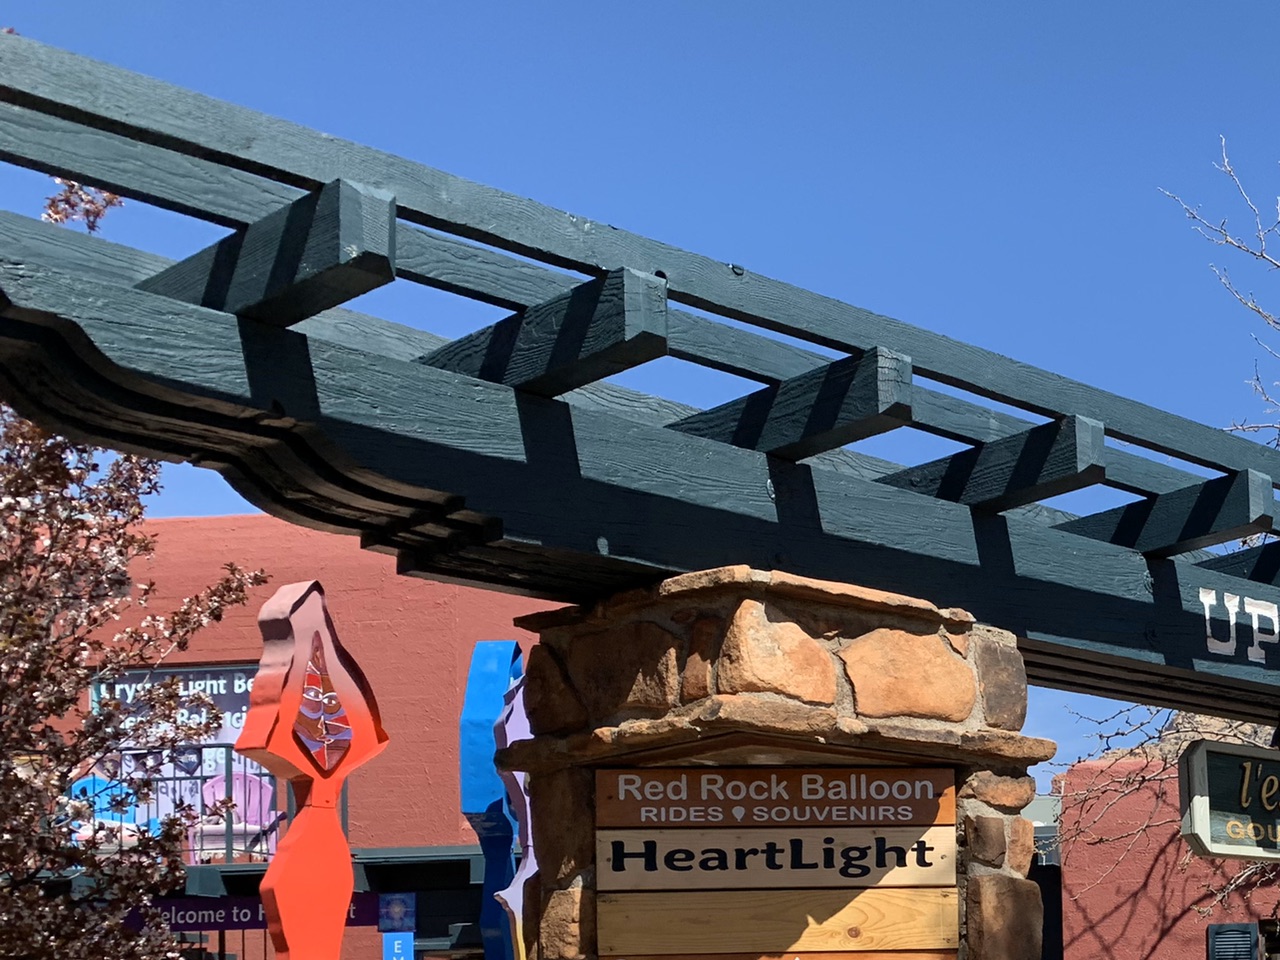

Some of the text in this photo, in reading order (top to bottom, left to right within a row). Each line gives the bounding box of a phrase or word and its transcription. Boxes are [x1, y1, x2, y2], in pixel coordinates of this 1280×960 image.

[177, 672, 227, 697] Light
[617, 772, 935, 801] Red Rock Balloon
[639, 805, 914, 823] RIDES SOUVENIRS
[610, 836, 935, 878] HeartLight
[152, 903, 226, 925] elcome
[231, 904, 251, 923] to
